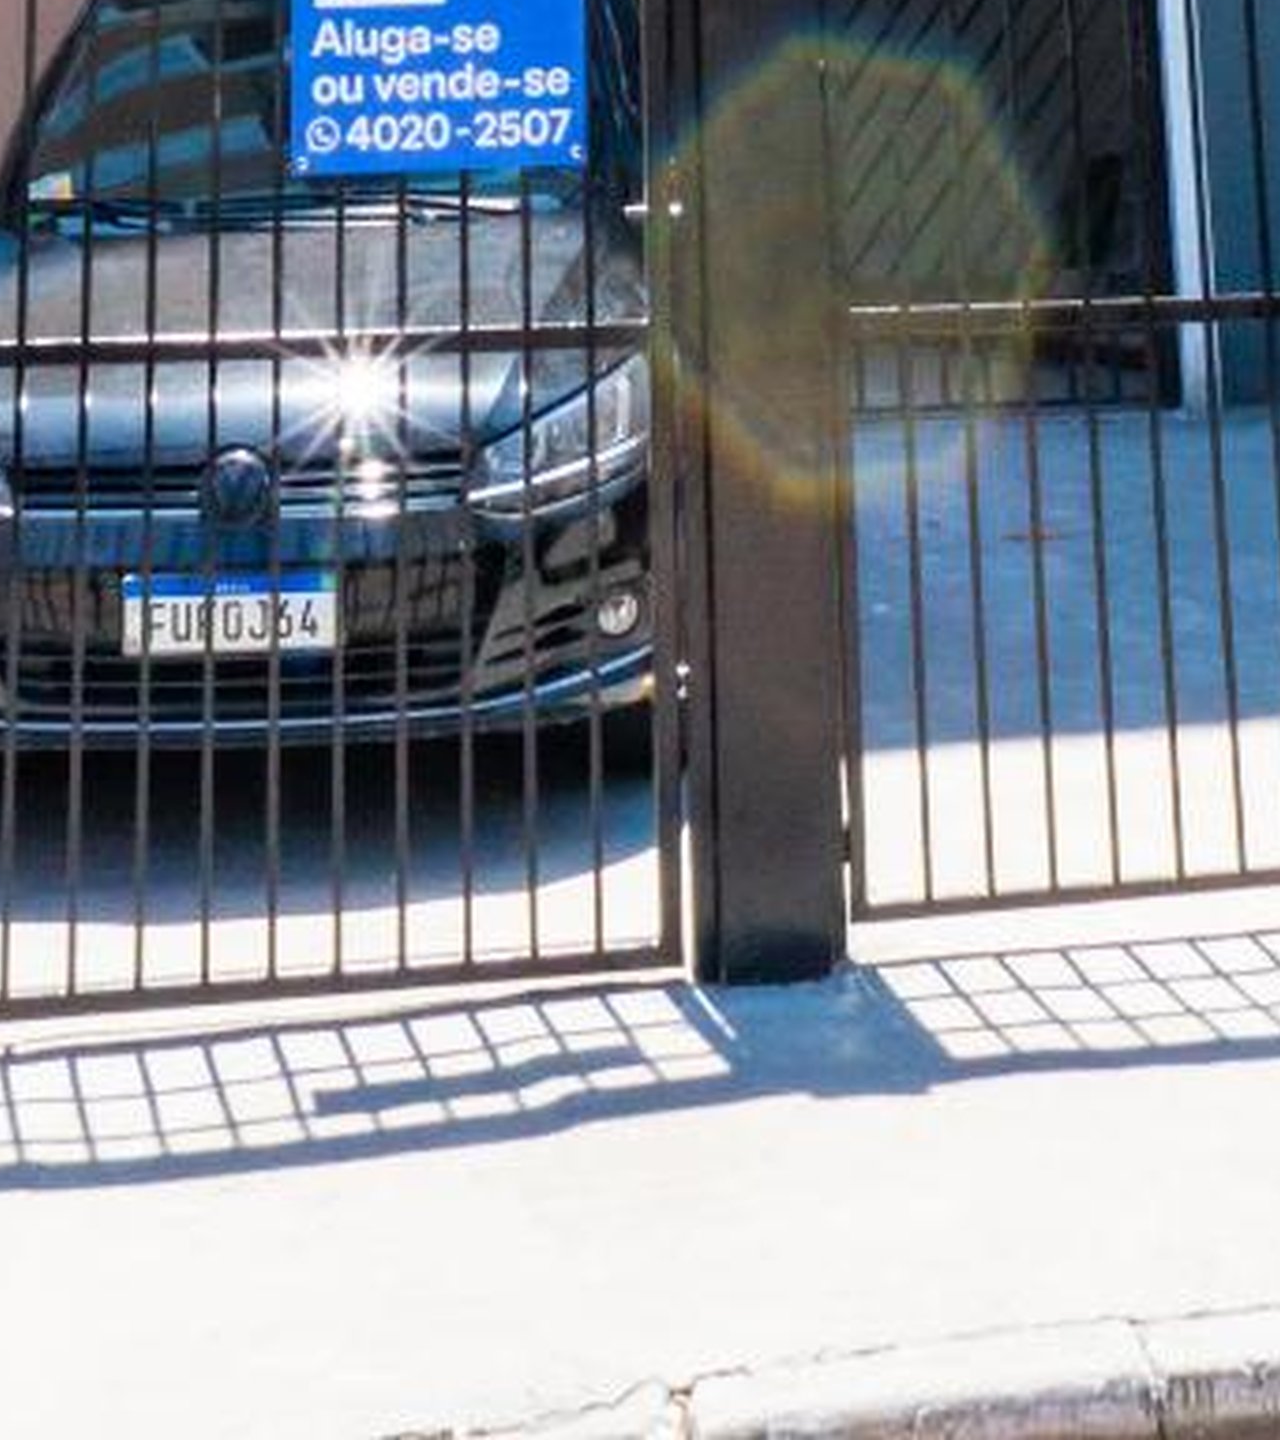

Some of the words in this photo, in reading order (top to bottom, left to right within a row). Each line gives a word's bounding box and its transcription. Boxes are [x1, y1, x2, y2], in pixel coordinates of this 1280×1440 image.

[311, 20, 500, 63] Aluga-se
[312, 77, 365, 104] ou
[375, 63, 570, 98] vende-se
[346, 109, 573, 152] 4020-2507
